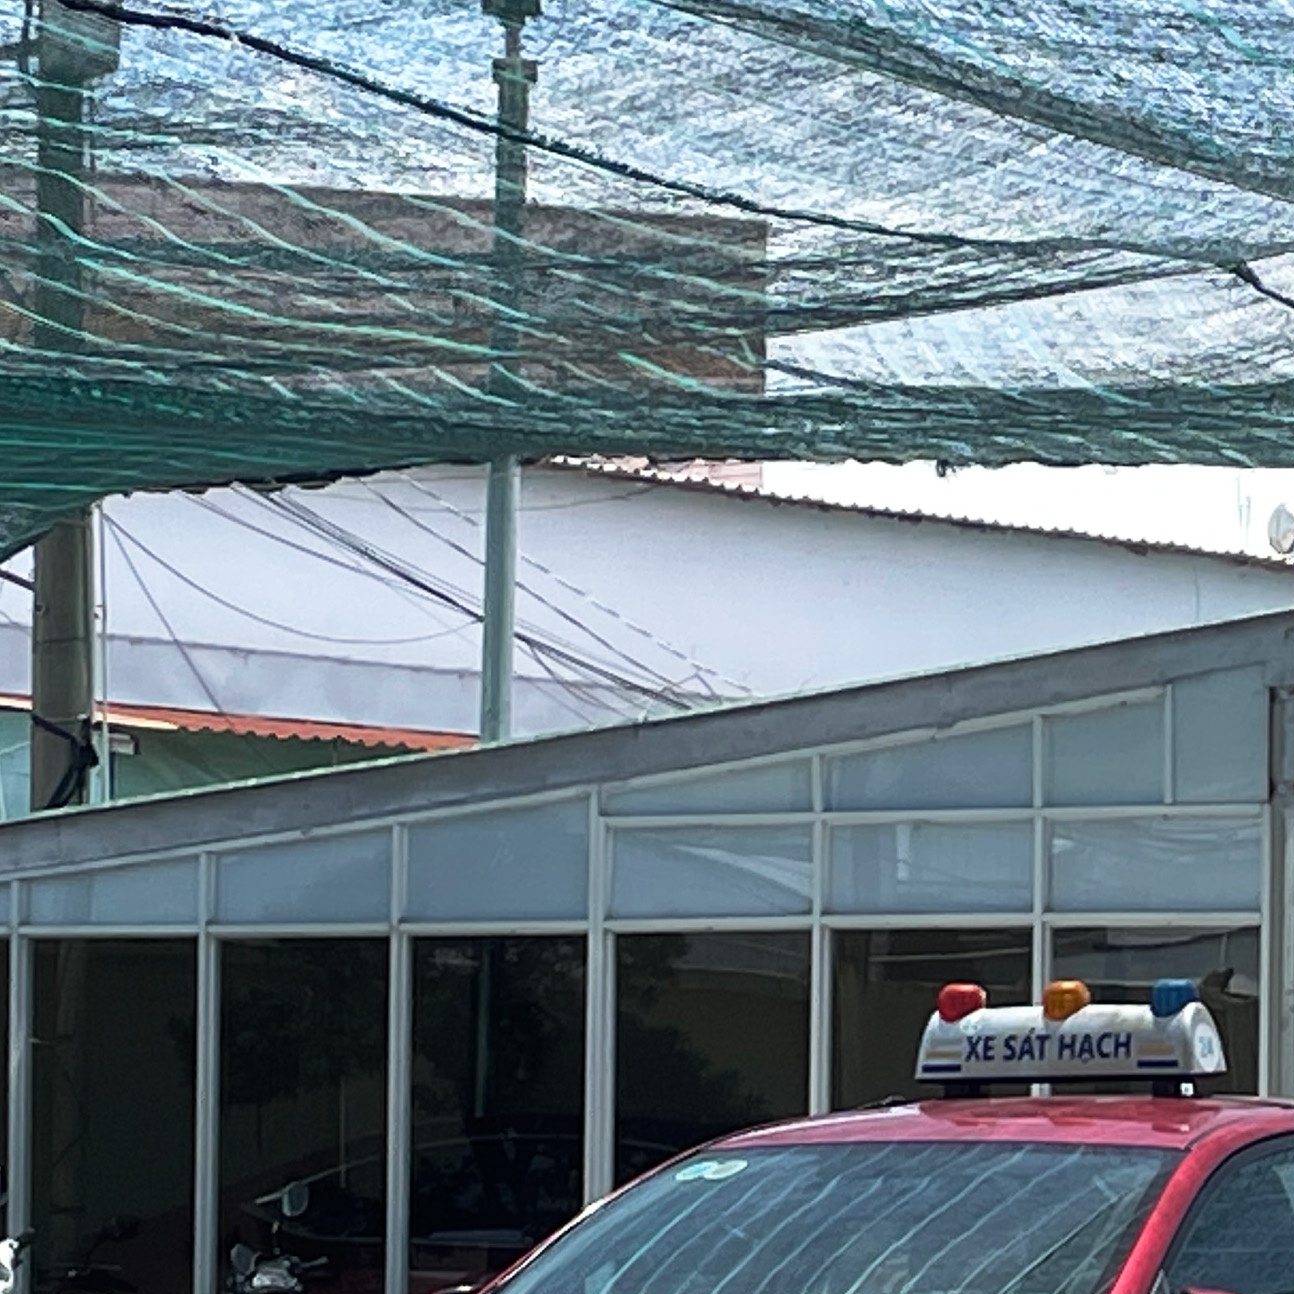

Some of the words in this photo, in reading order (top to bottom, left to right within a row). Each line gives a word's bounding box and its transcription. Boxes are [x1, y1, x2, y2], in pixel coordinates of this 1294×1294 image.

[964, 1035, 996, 1062] XE
[1003, 1027, 1051, 1061] SÁT
[1058, 1032, 1132, 1063] HẠCH
